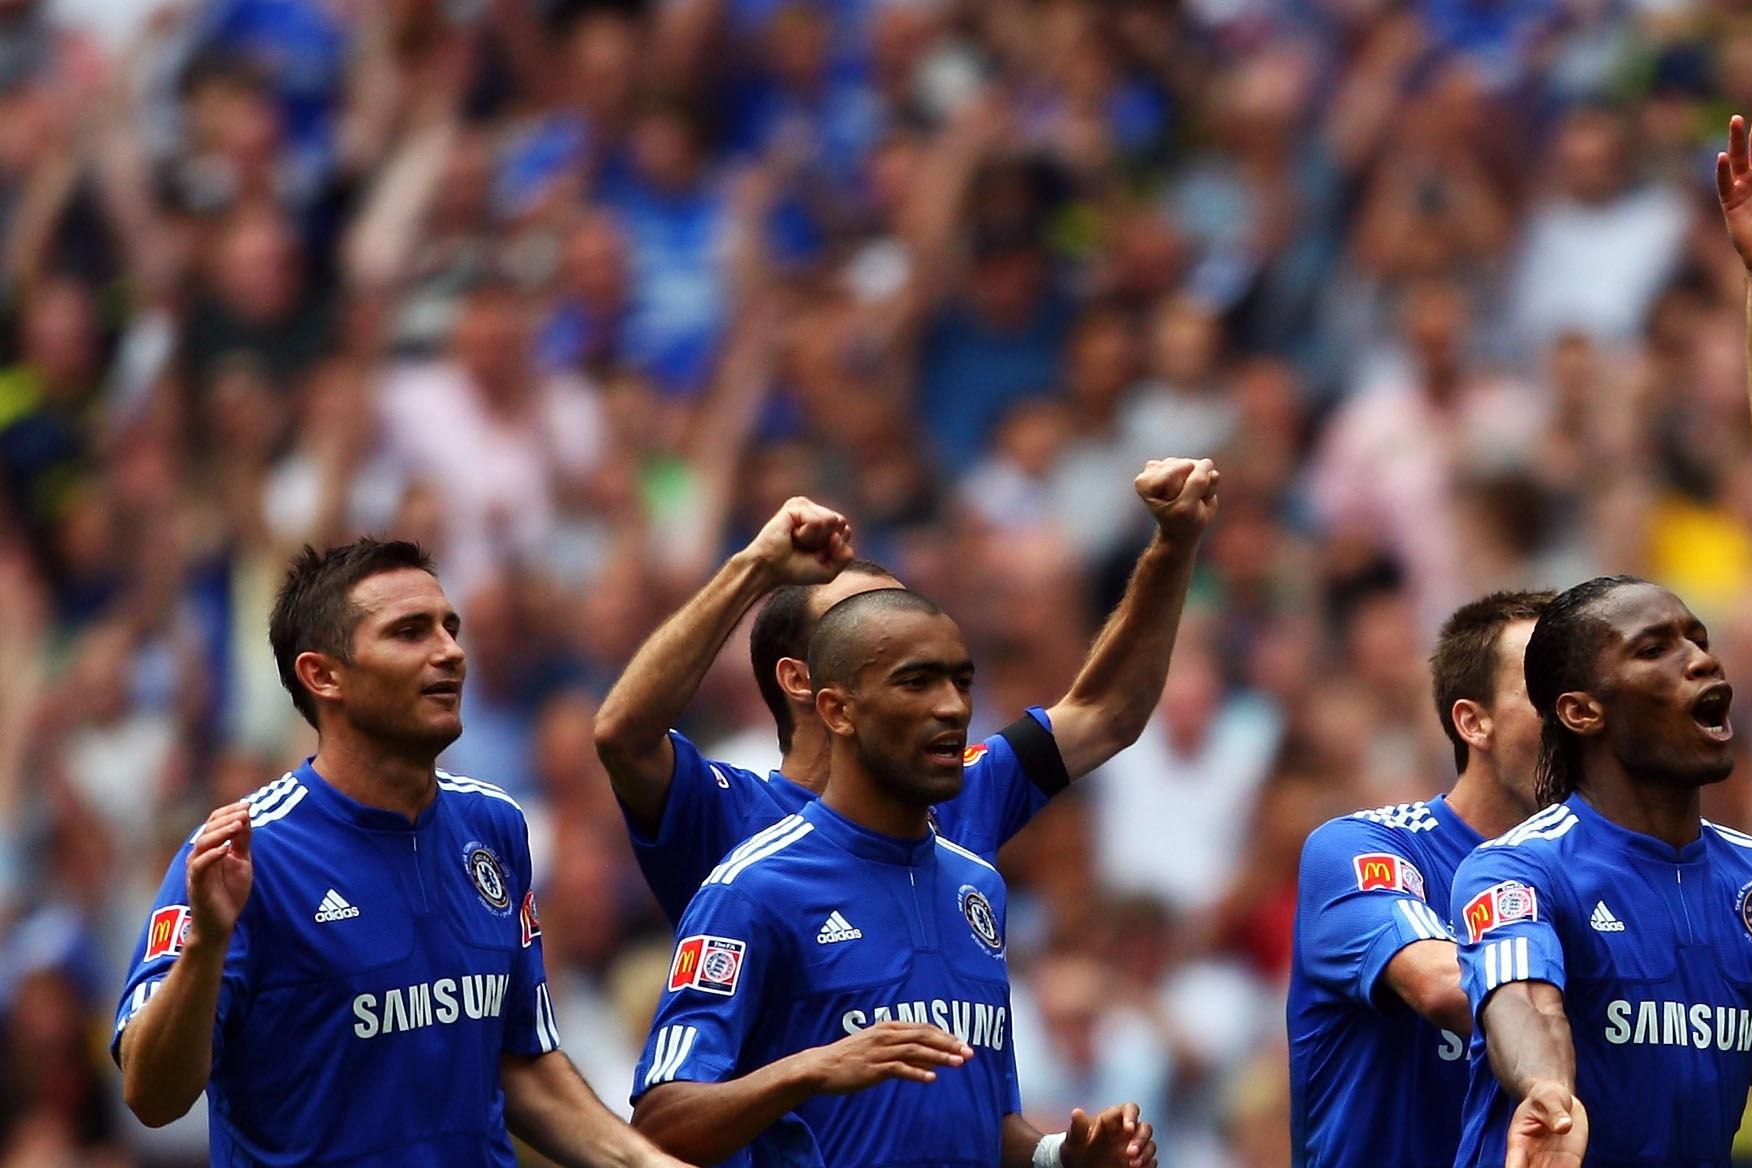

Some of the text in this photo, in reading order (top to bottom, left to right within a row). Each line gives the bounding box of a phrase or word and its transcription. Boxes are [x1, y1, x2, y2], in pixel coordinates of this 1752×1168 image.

[315, 905, 360, 924] adidas
[816, 927, 862, 945] adidas
[353, 974, 510, 1039] SAMSUN
